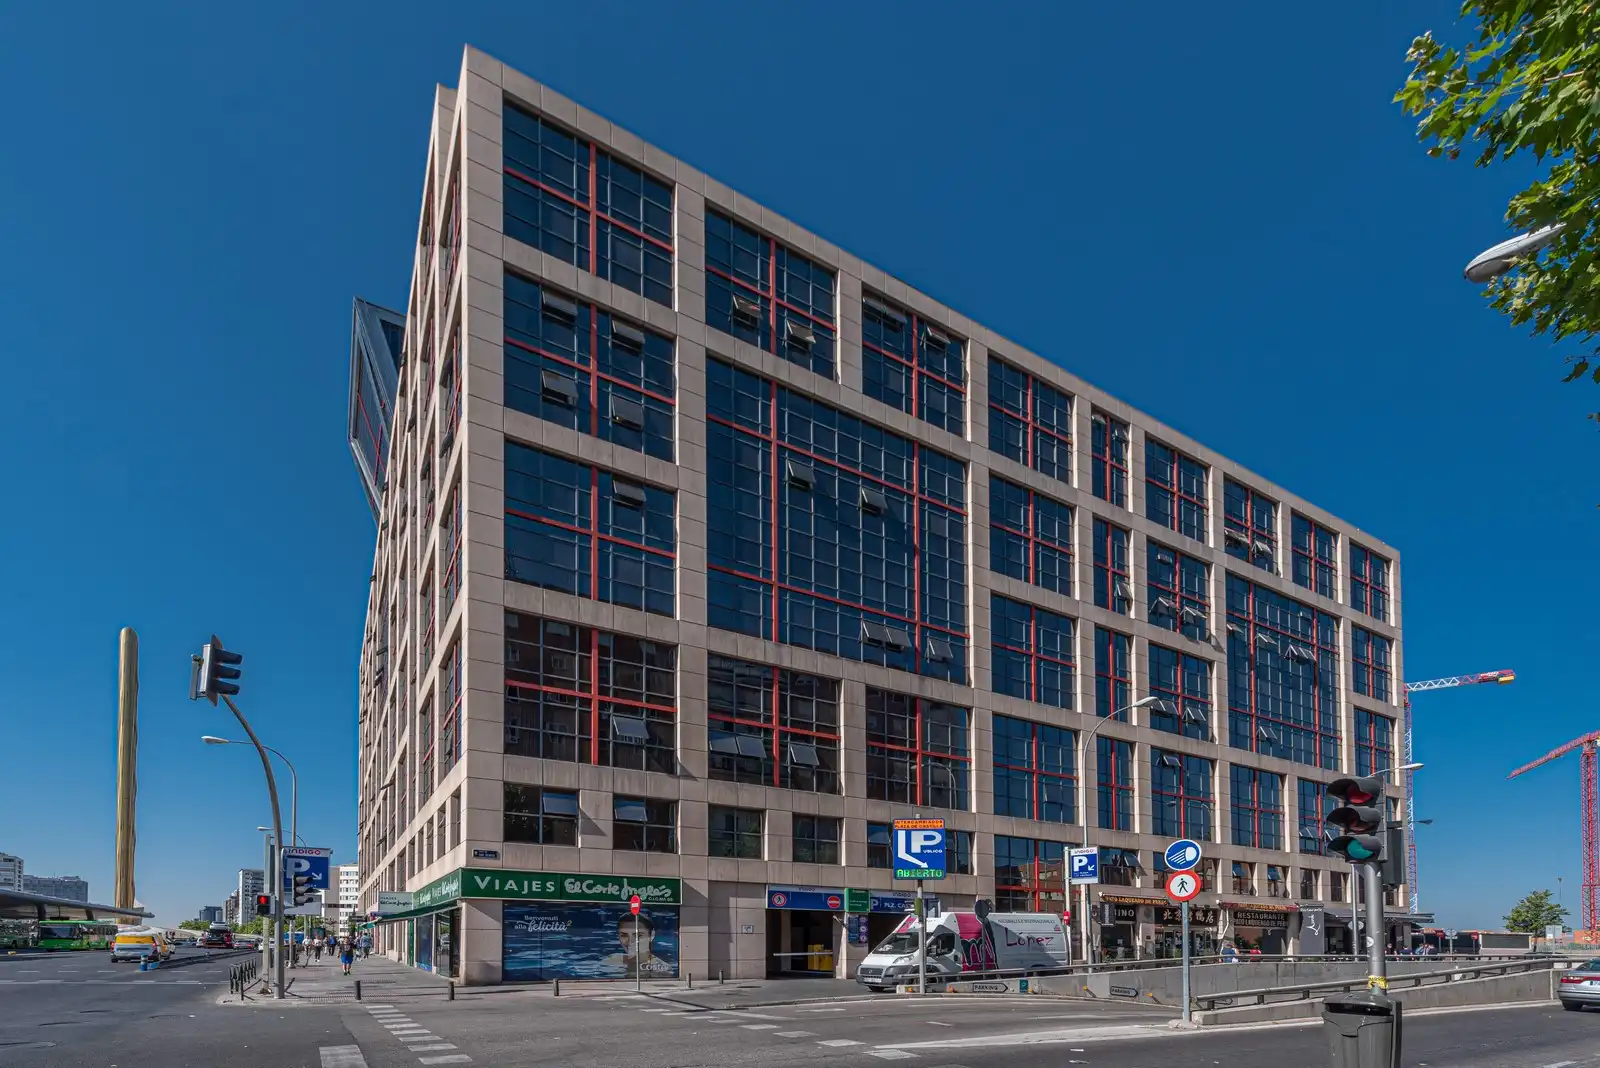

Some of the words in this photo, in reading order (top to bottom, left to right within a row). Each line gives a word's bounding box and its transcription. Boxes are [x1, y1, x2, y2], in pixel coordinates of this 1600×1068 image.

[911, 830, 942, 853] P
[286, 857, 310, 878] P
[1073, 855, 1088, 872] P
[897, 869, 943, 878] ABIERTO
[564, 878, 582, 893] El
[582, 879, 620, 895] Corte
[620, 878, 672, 901] Inglés
[1237, 911, 1285, 920] RESTAURANTE
[527, 919, 568, 932] felicità
